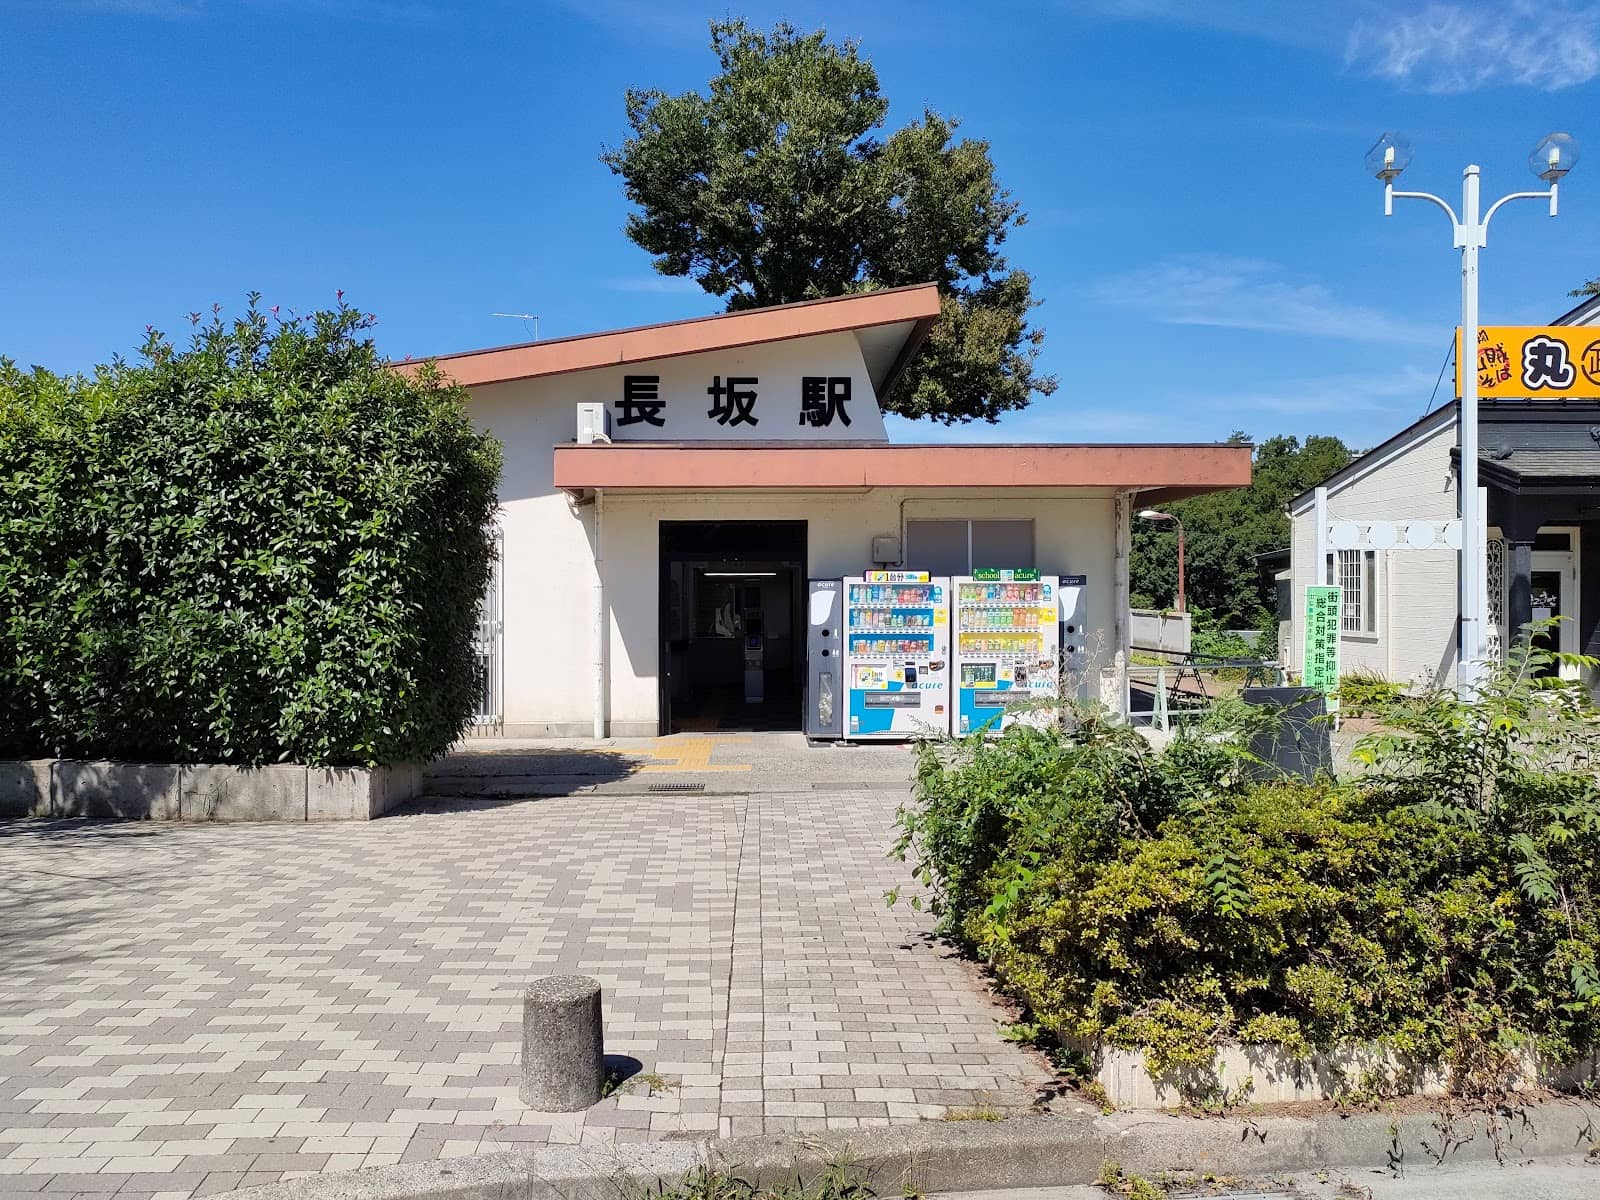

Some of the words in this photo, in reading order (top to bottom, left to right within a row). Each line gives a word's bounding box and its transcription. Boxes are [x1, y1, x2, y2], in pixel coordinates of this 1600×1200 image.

[615, 375, 852, 427] 長坂駅
[978, 571, 1000, 579] school
[1325, 591, 1338, 685] 街頭犯罪等抑止
